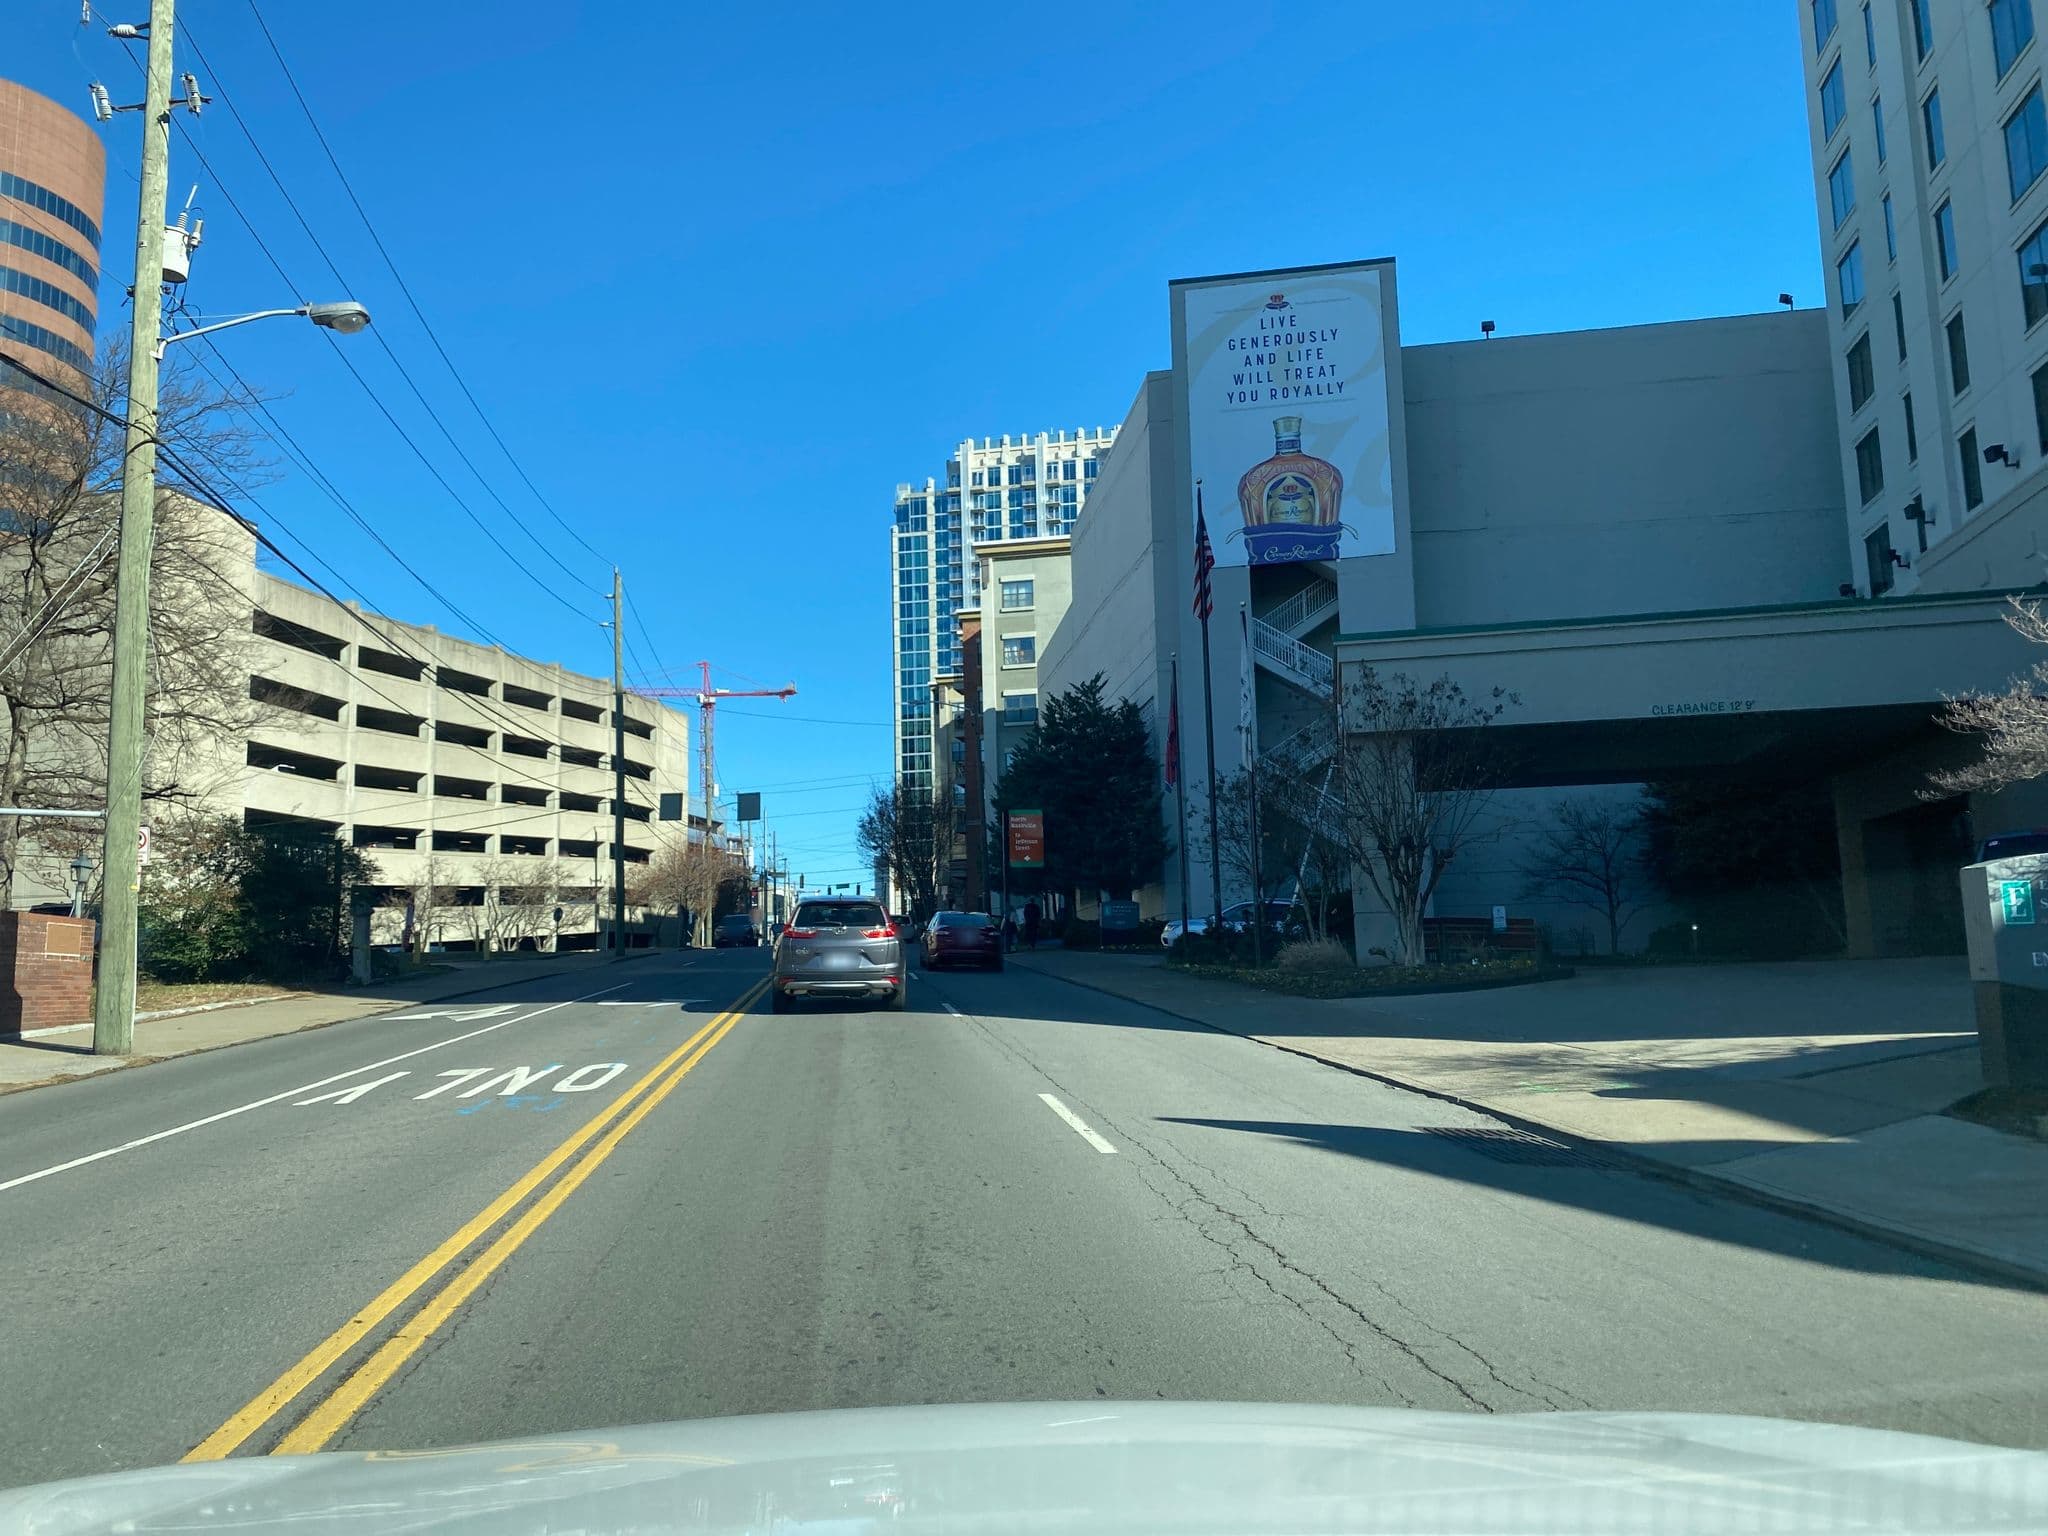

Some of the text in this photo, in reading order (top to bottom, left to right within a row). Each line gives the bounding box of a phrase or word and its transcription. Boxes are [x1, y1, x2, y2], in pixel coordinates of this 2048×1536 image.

[1260, 315, 1297, 330] LIVE
[1228, 328, 1338, 351] GENEROUSLY
[1244, 347, 1324, 367] AND LIFE
[1233, 364, 1337, 386] WILL TREAT
[1227, 381, 1344, 404] YOU ROYALLY
[1651, 701, 1725, 716] CLEARANCE
[292, 1062, 629, 1106] ONLY
